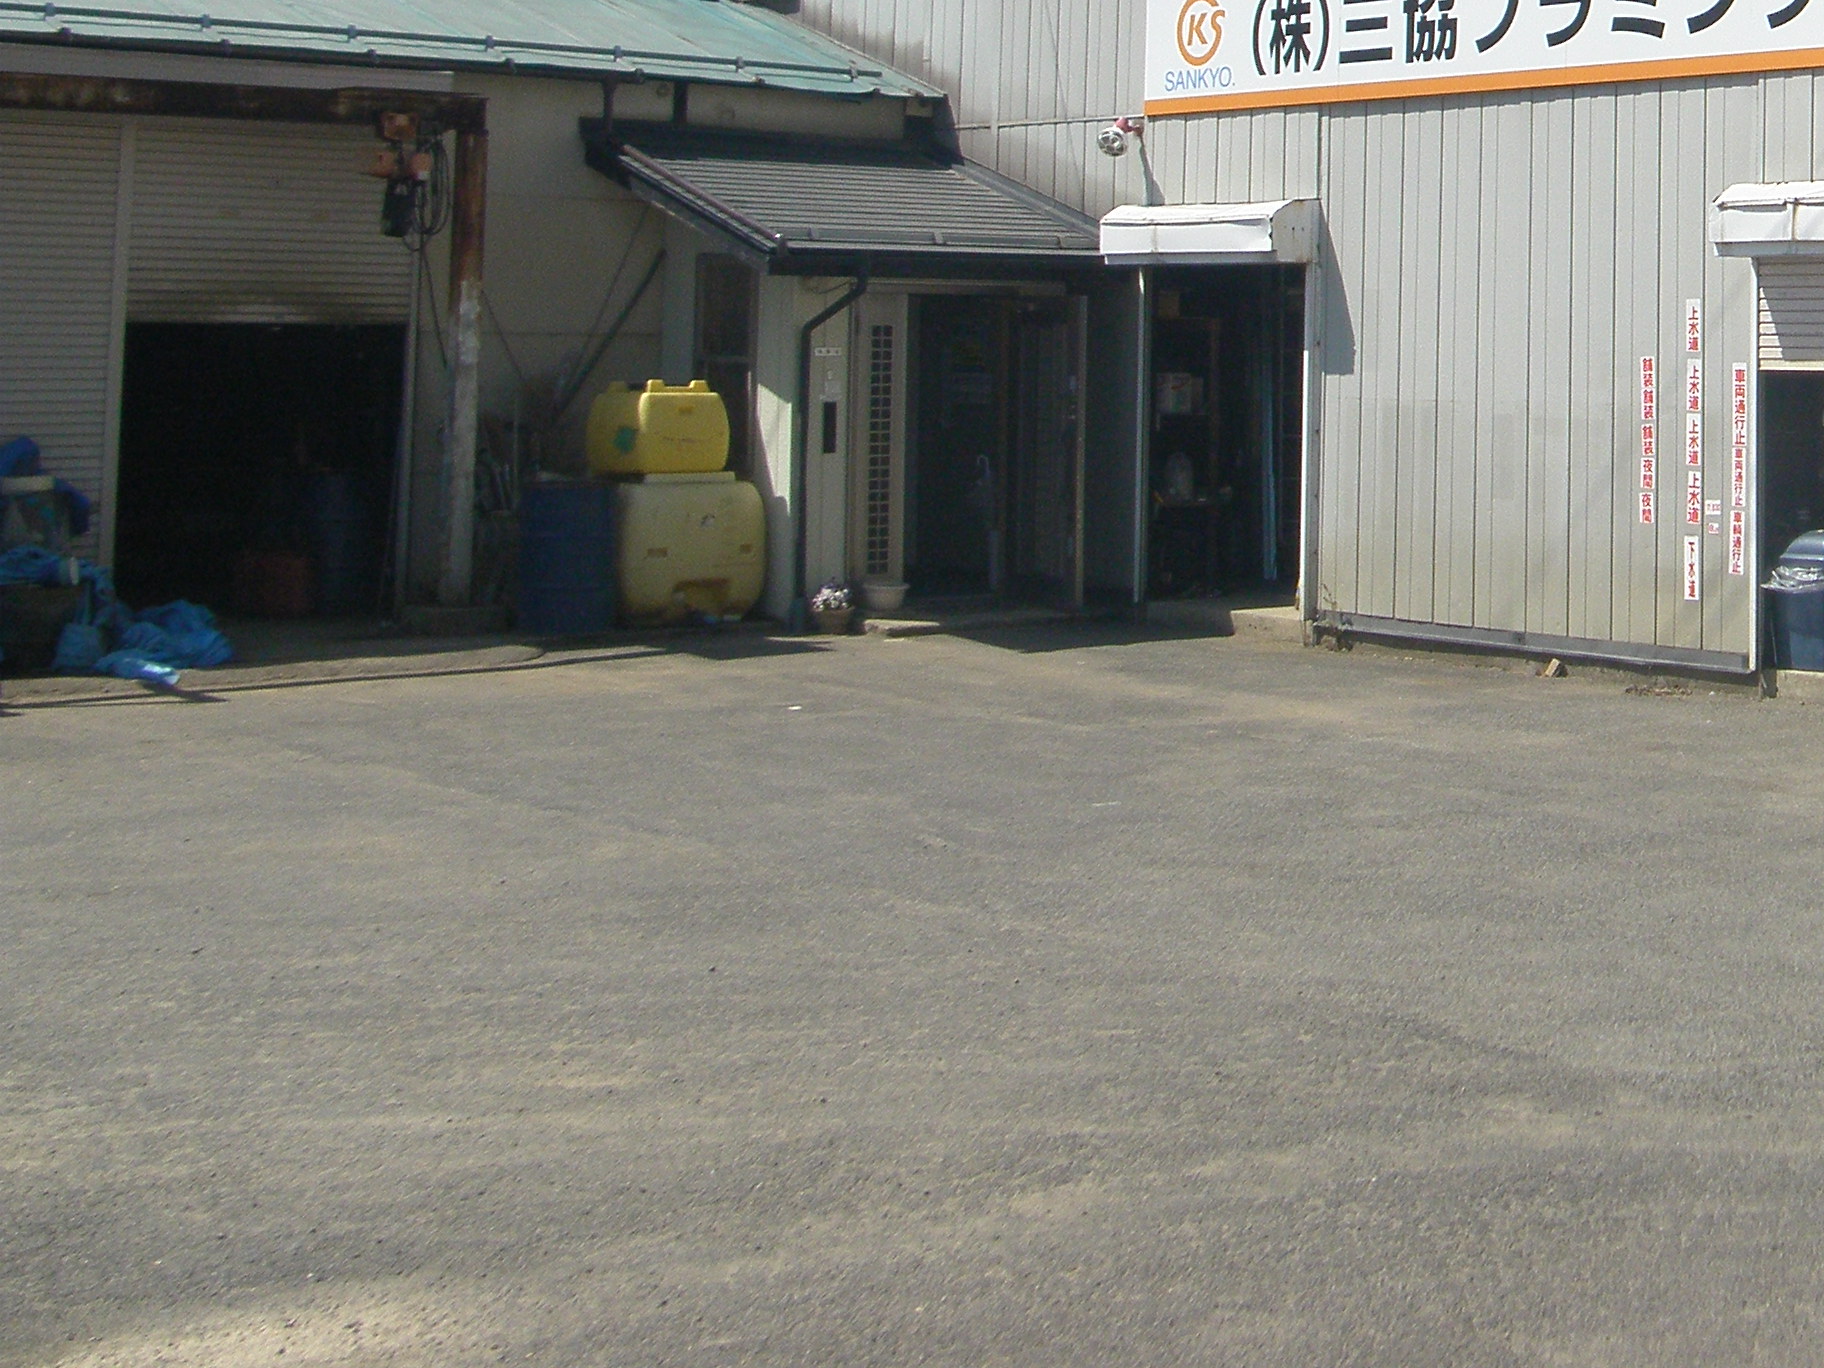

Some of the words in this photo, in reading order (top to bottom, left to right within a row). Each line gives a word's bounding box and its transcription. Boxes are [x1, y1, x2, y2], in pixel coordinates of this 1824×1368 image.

[1688, 306, 1699, 350] 上水道
[1689, 365, 1699, 410] 上水道
[1735, 369, 1745, 445] 車両通行止
[1688, 419, 1699, 464] 上水道
[1688, 473, 1700, 523] 上水道
